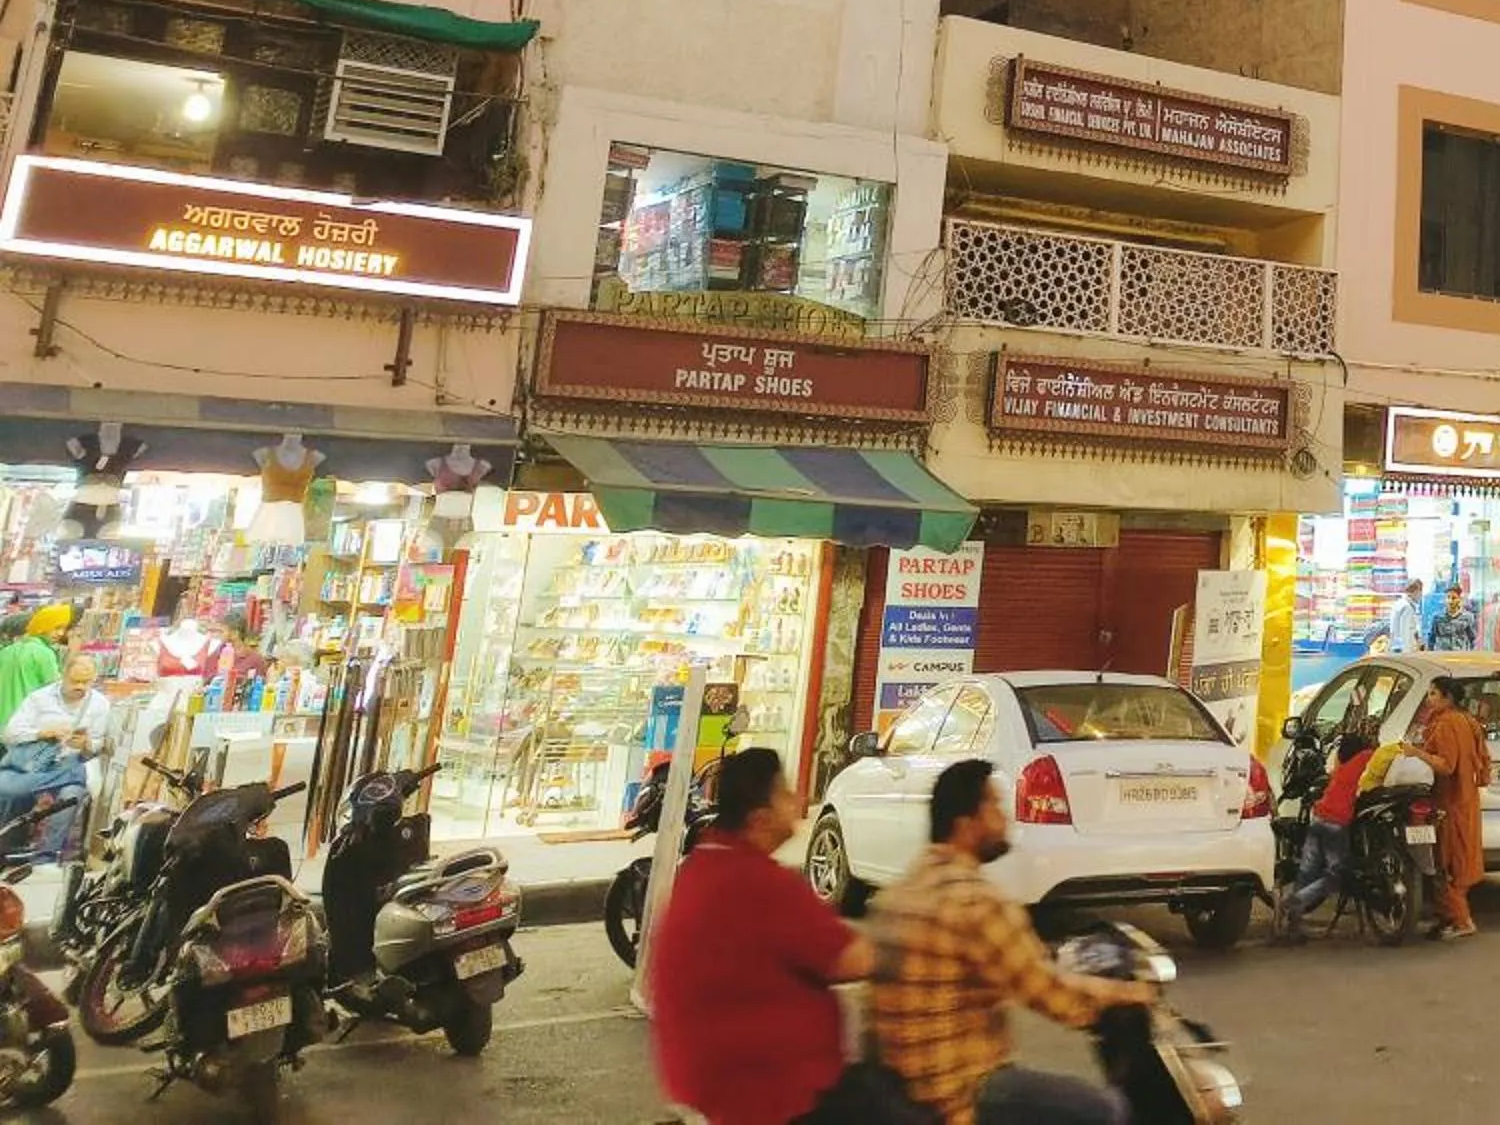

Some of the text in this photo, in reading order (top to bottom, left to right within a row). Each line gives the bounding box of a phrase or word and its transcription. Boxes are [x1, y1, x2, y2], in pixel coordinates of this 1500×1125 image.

[1161, 127, 1281, 162] MAHAJAN ASSOCIATES
[183, 203, 302, 237] ਅਗਰਵਾਲ
[149, 228, 400, 276] AGGARWAL HOSIERY
[675, 368, 814, 398] PARTAP SHOES
[1003, 396, 1280, 436] VIJAY FINANCIAL & INVESTMENT CONSULTANTS
[504, 492, 601, 527] PAR
[898, 557, 977, 576] PARTAP
[901, 581, 968, 600] SHOES
[908, 609, 937, 621] Deals
[889, 621, 903, 633] All
[943, 623, 973, 634] Gents
[900, 635, 922, 646] Kids
[923, 636, 971, 647] Footwear
[913, 661, 966, 674] CAMPUS
